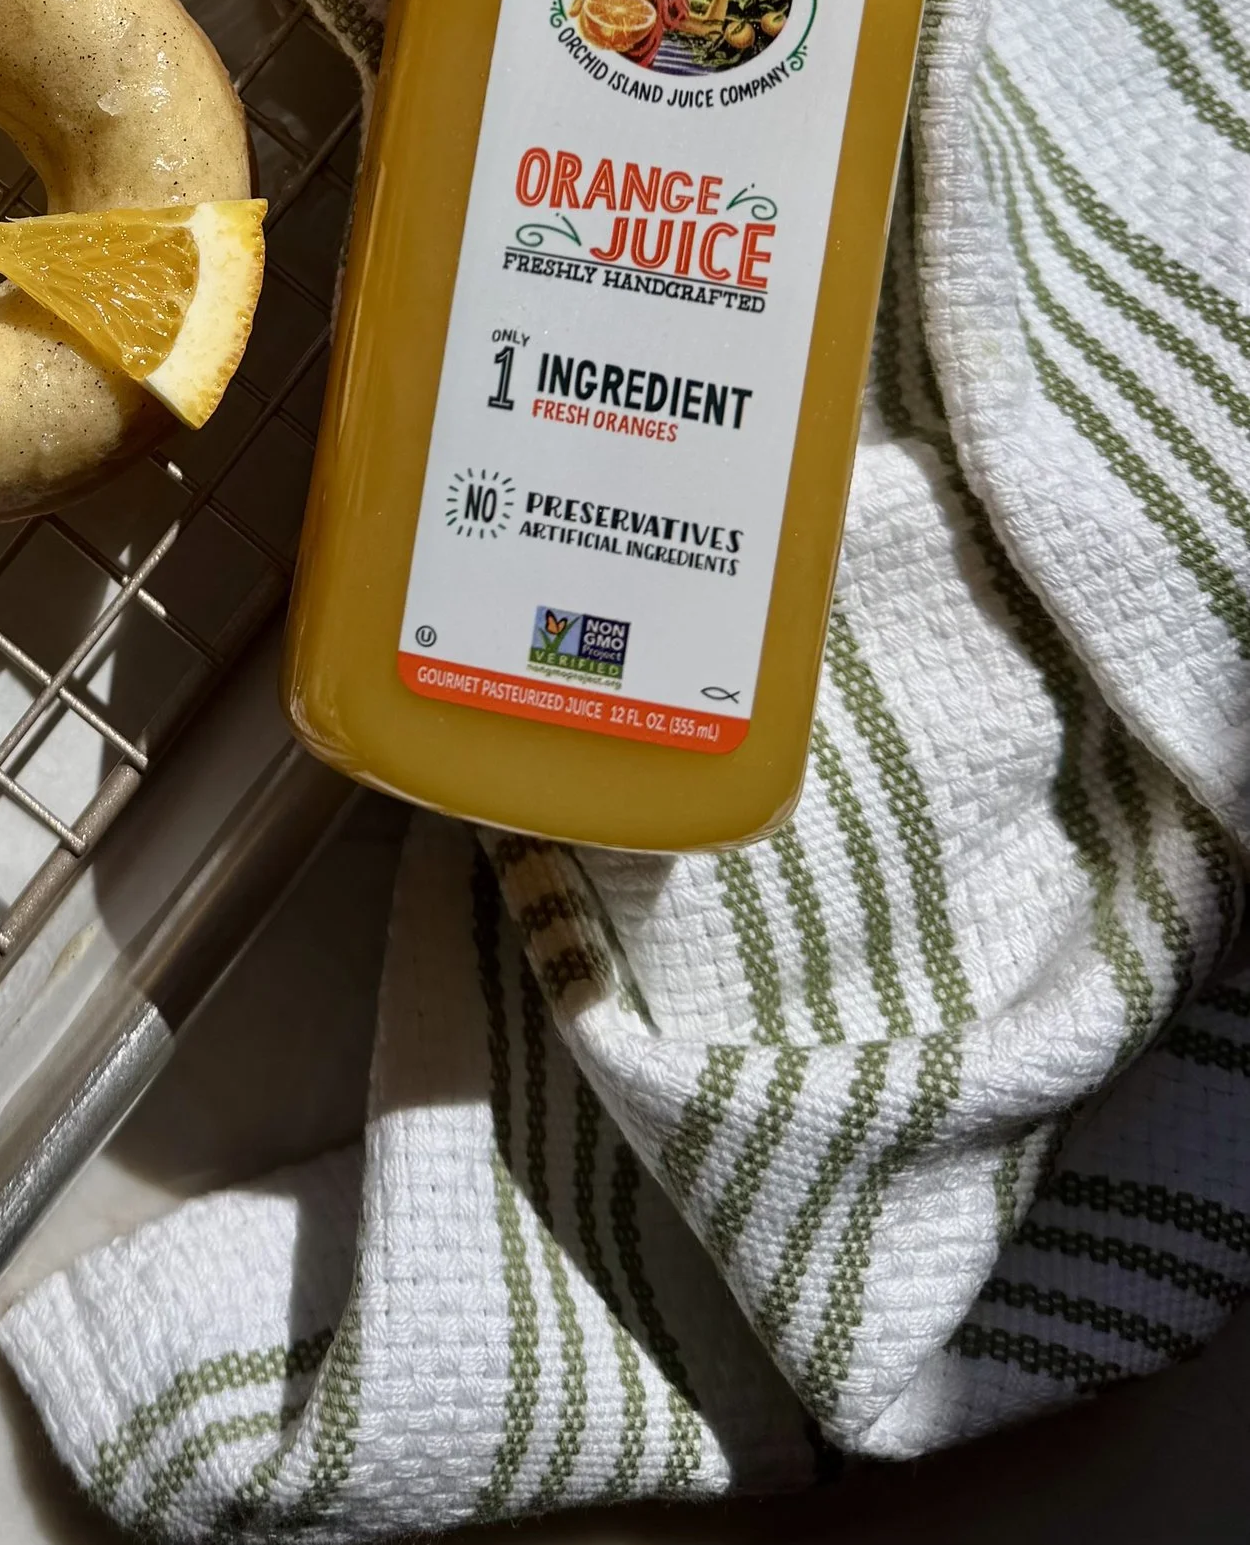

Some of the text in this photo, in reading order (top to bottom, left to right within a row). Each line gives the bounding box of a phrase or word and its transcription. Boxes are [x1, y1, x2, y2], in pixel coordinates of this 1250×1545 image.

[557, 27, 791, 109] ORCHID ISLAND JUICE COMPANY
[515, 146, 724, 216] ORANGE
[502, 251, 766, 314] FRESHLY HANDCRAFTED
[589, 216, 777, 289] JUICE
[491, 328, 531, 347] ONLY
[487, 345, 753, 430] 1 INGREDIENT
[532, 397, 679, 443] FRESH ORANGES
[464, 483, 745, 555] NO PRESERVATIVES
[519, 520, 740, 577] ARTIFICIAL INGREDIENTS
[581, 644, 622, 662] Project
[583, 632, 625, 651] GMO
[585, 618, 625, 638] NON
[534, 650, 620, 676] VERIFIED
[417, 665, 481, 694] GOURMET
[481, 678, 564, 713] PASTEURIZED
[564, 697, 603, 720] JUICE
[609, 705, 626, 723] 12
[646, 712, 667, 732] OZ.
[668, 715, 695, 738] (355
[696, 722, 720, 743] mL)
